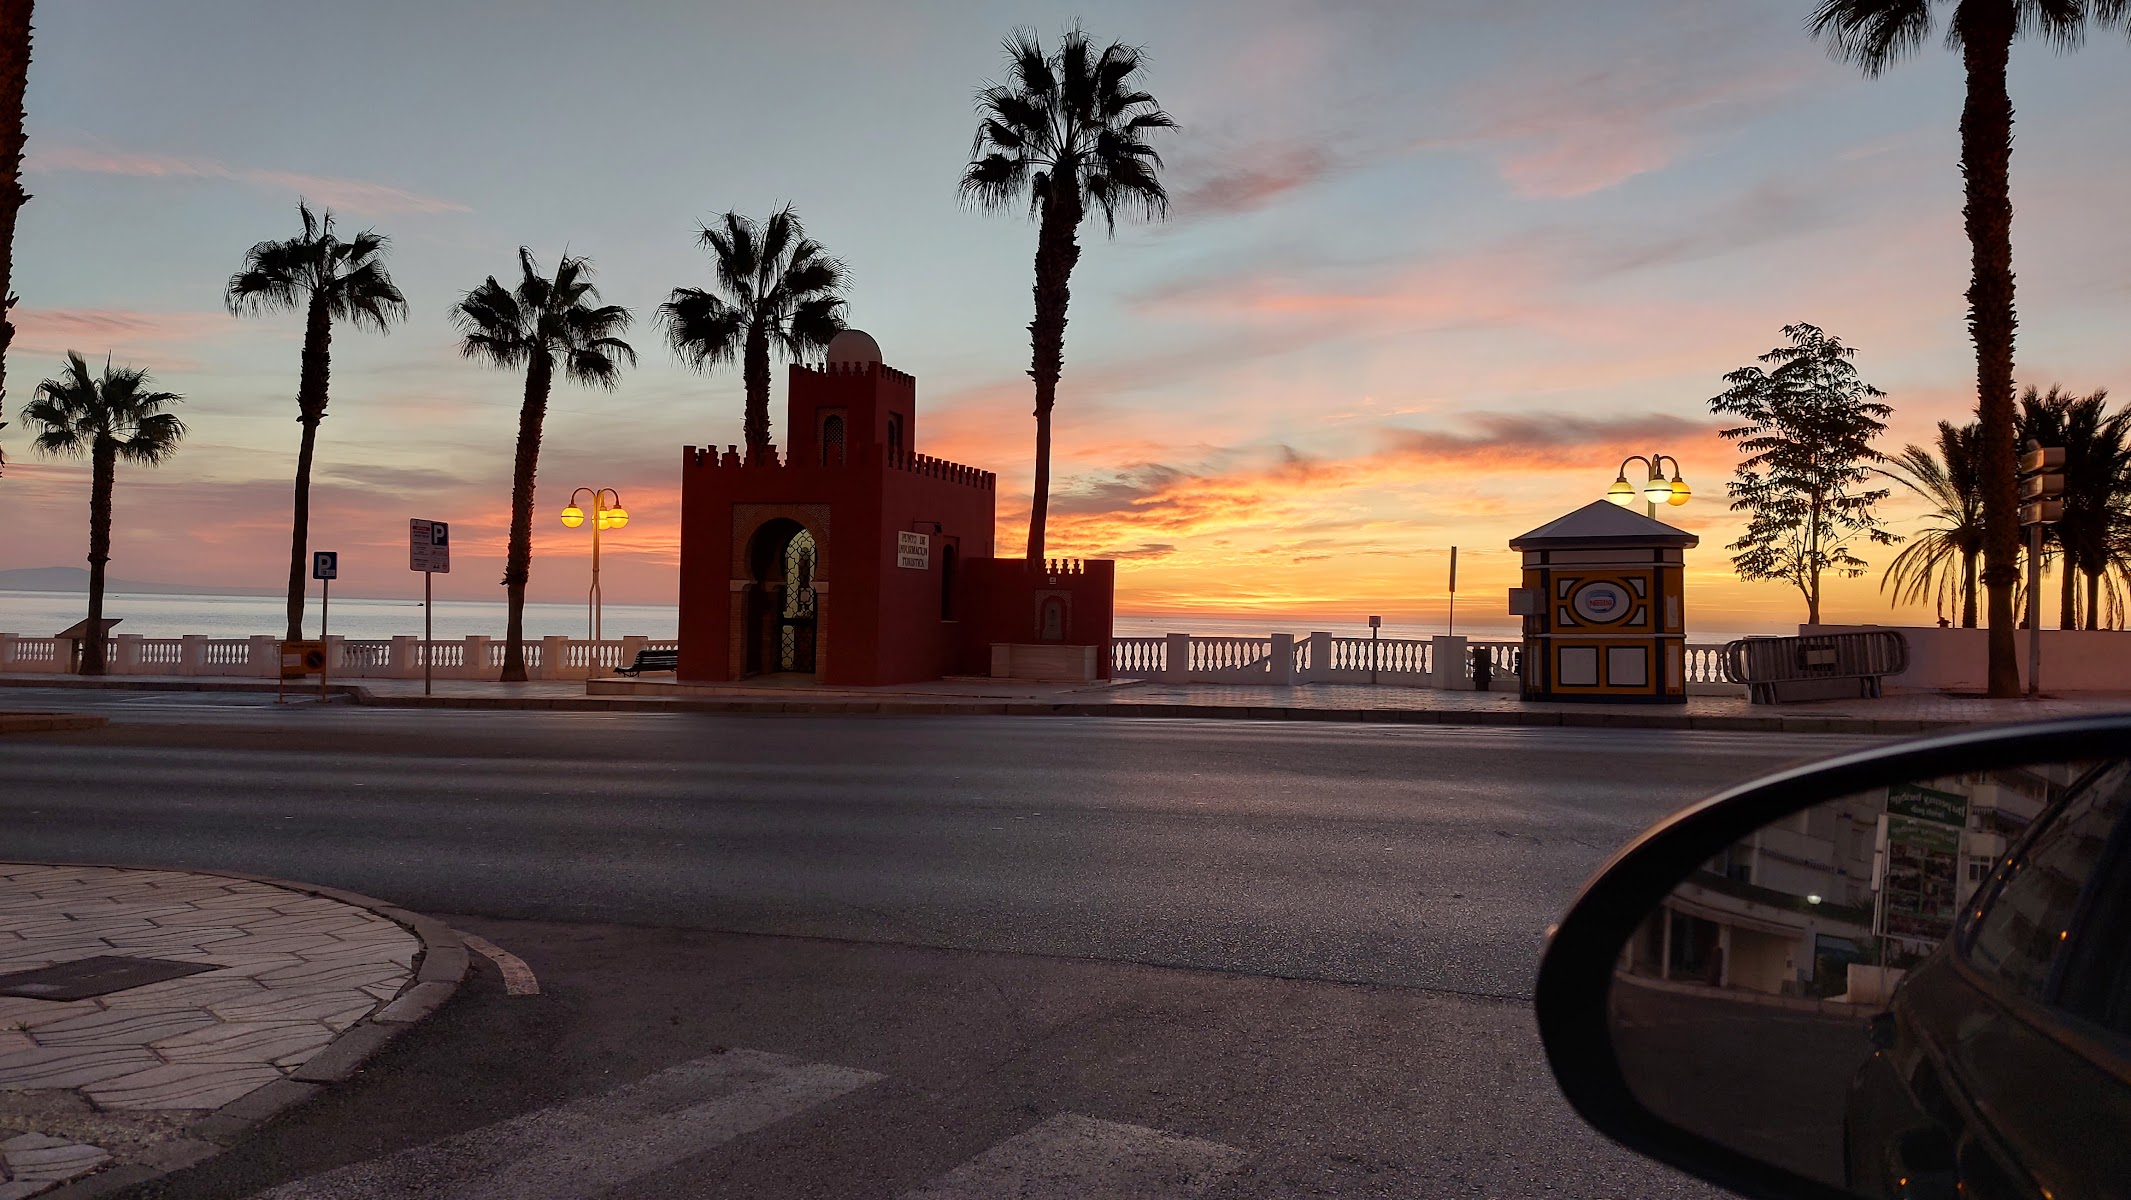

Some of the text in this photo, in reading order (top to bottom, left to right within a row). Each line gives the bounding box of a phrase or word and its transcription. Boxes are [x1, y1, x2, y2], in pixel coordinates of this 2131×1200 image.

[433, 524, 445, 544] P
[902, 533, 926, 545] PUNTO DE
[318, 555, 332, 576] P
